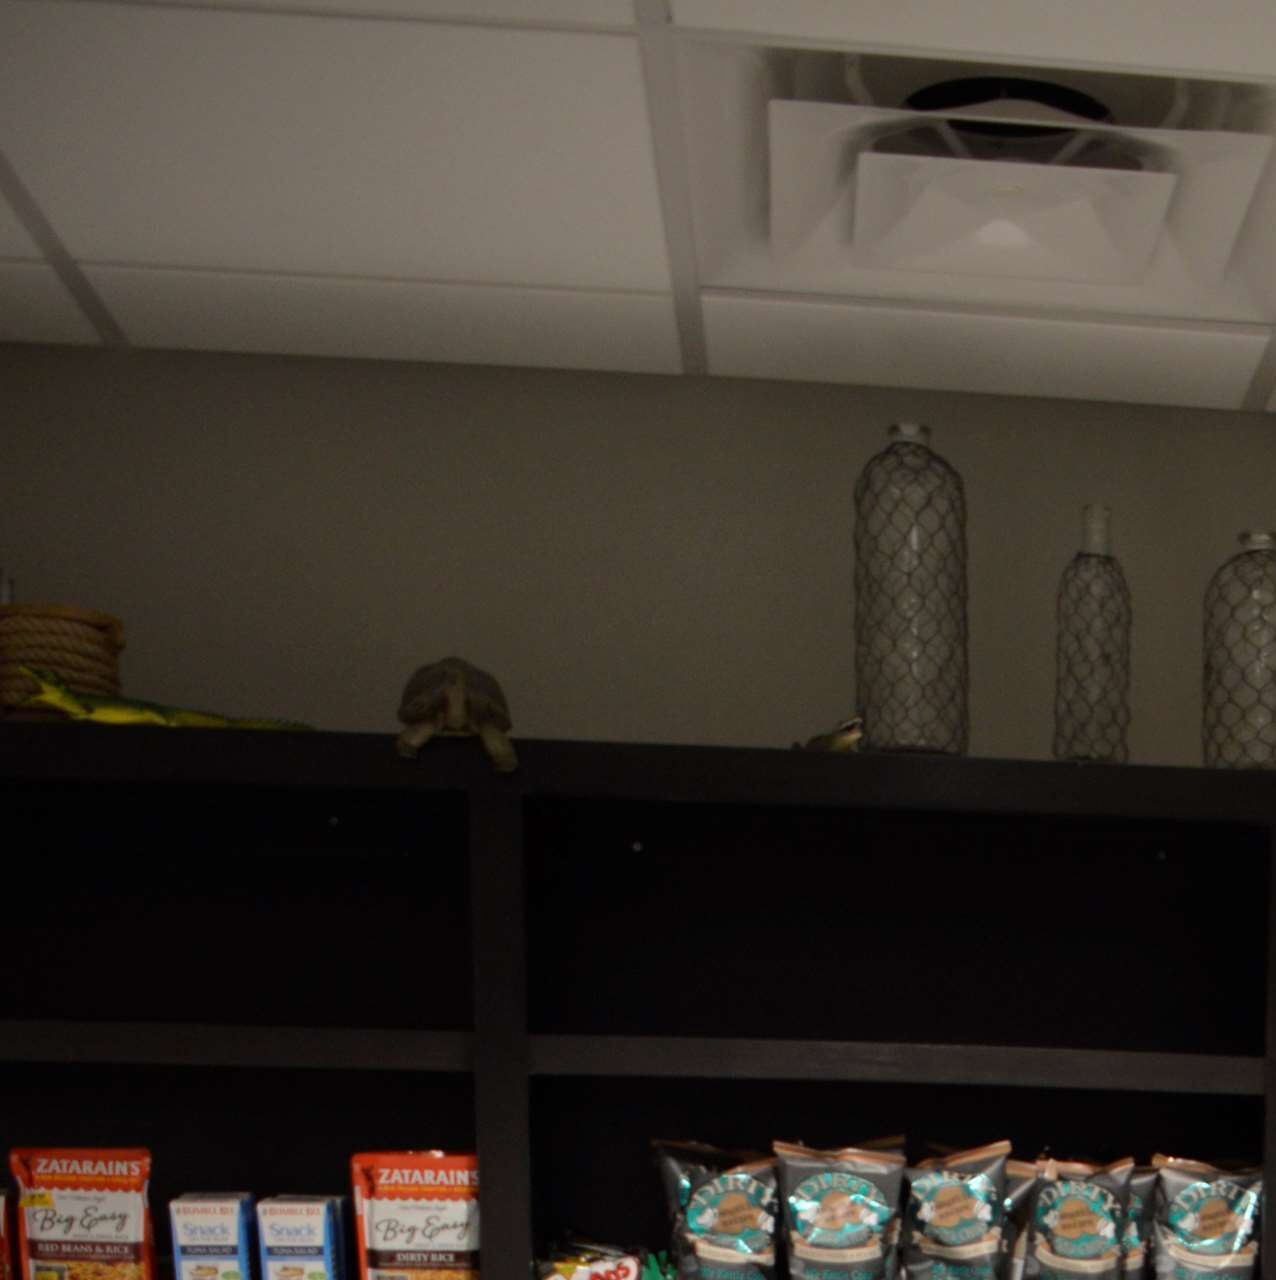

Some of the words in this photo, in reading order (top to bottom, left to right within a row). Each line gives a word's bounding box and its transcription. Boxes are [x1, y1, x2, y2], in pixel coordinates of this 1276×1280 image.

[33, 1207, 76, 1234] Big
[80, 1206, 129, 1232] Easy
[183, 1222, 230, 1237] Snack
[270, 1222, 318, 1237] Snack
[375, 1218, 420, 1245] Big
[421, 1214, 472, 1241] Easy
[37, 1242, 59, 1253] RED
[61, 1243, 93, 1254] BEANS
[105, 1244, 131, 1255] RICE
[396, 1252, 428, 1263] DIRTY
[431, 1253, 455, 1263] RICE
